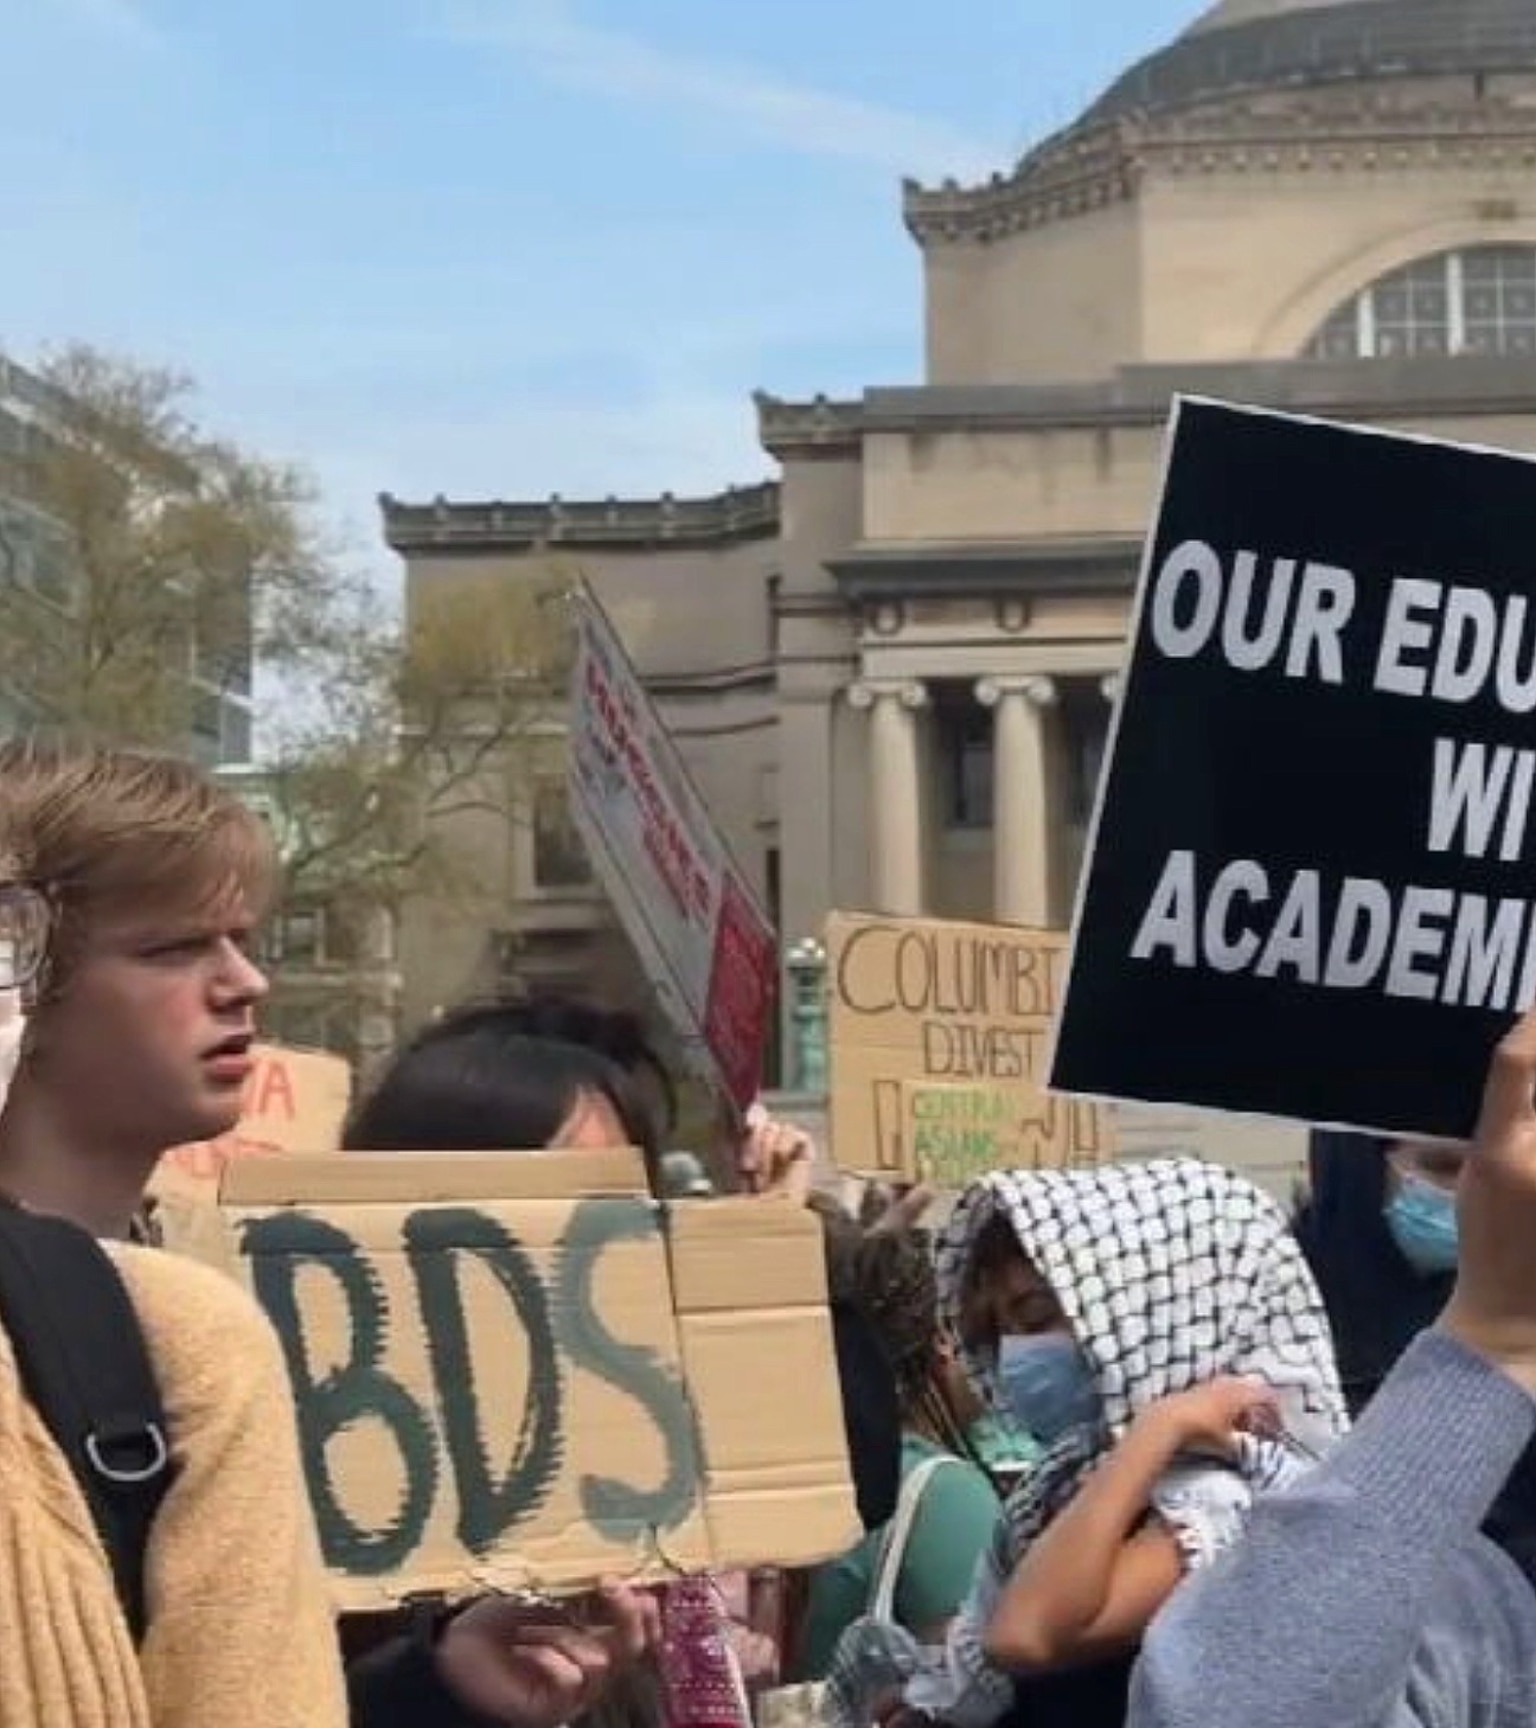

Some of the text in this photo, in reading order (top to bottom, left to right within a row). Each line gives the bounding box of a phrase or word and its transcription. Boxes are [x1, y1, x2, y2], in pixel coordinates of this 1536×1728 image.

[1150, 538, 1356, 684] OUR
[836, 924, 1068, 1017] COLUMBI
[922, 1019, 1047, 1078] DIVEST
[237, 1198, 706, 1576] BDS
